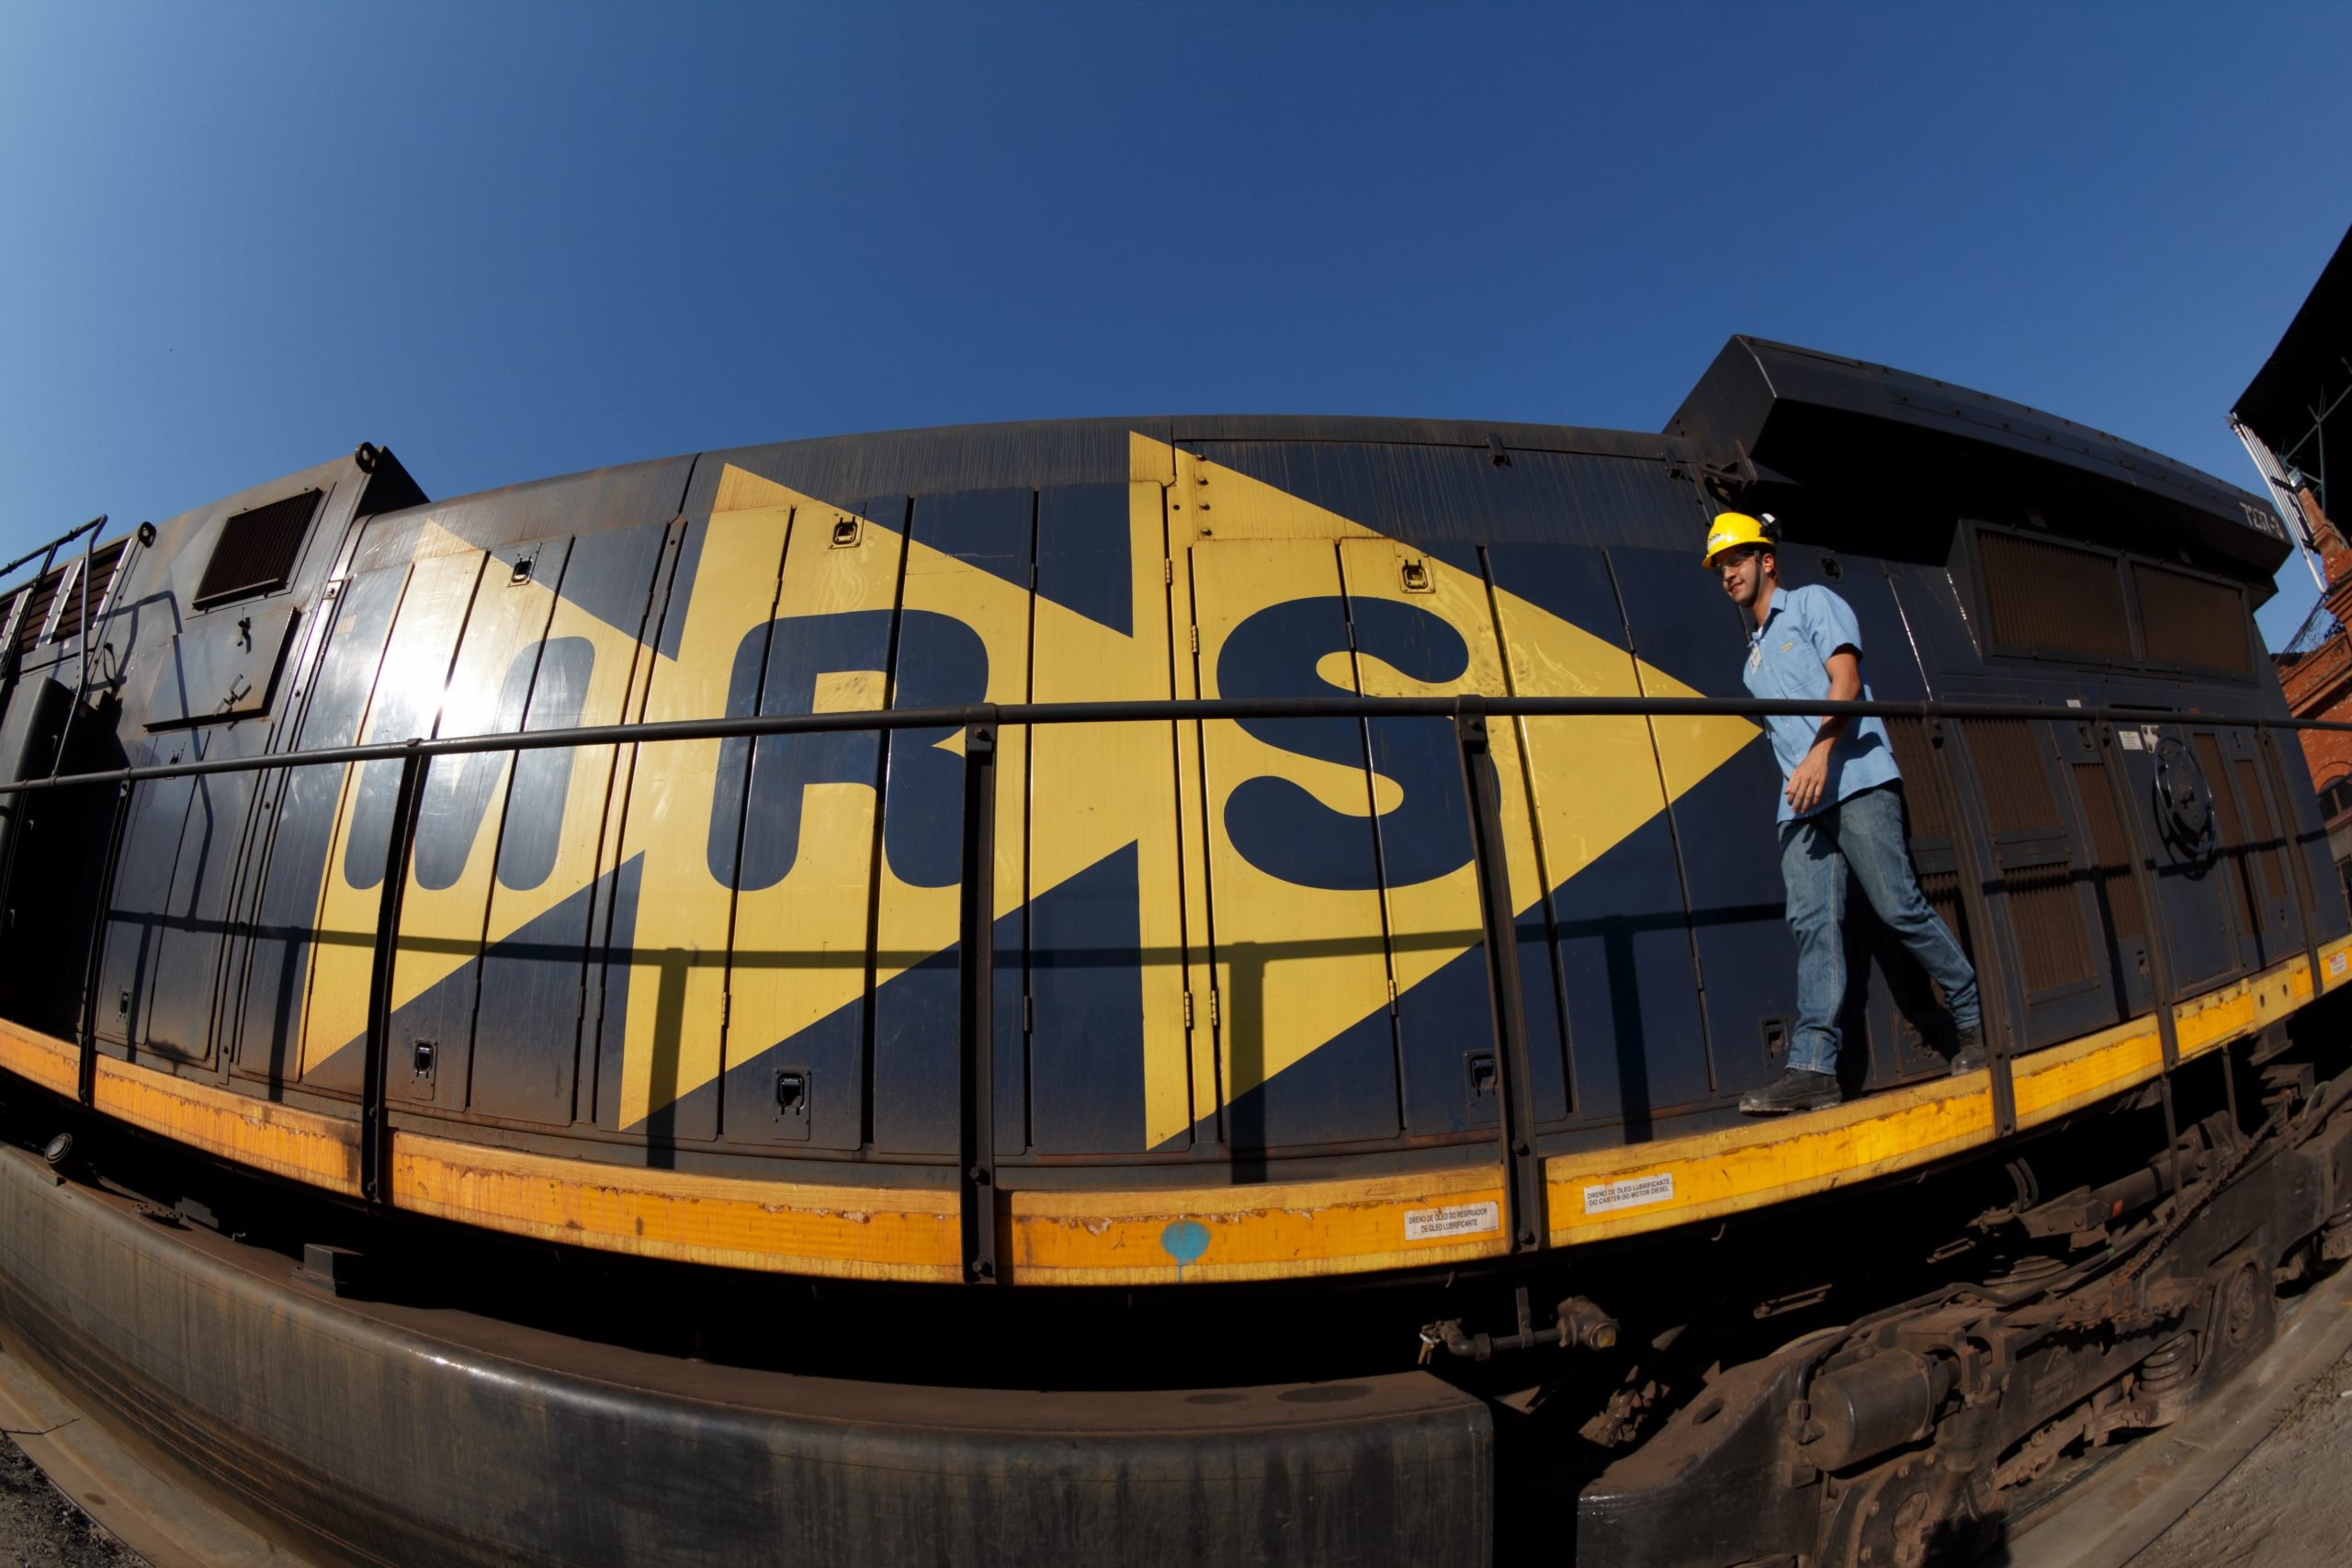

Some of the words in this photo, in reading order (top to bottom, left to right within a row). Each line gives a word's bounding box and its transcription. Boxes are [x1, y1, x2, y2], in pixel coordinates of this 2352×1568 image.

[344, 595, 1501, 891] MRS
[1588, 1190, 1607, 1199] DRENO
[1633, 1179, 1669, 1190] LUBRIFICANTE
[1631, 1189, 1649, 1198] MOTOR
[1651, 1186, 1669, 1194] DIESEL
[1408, 1215, 1426, 1224] DRENO
[1457, 1208, 1487, 1218] RESFRIADOR
[1443, 1219, 1477, 1230] LUBRIFICANTE
